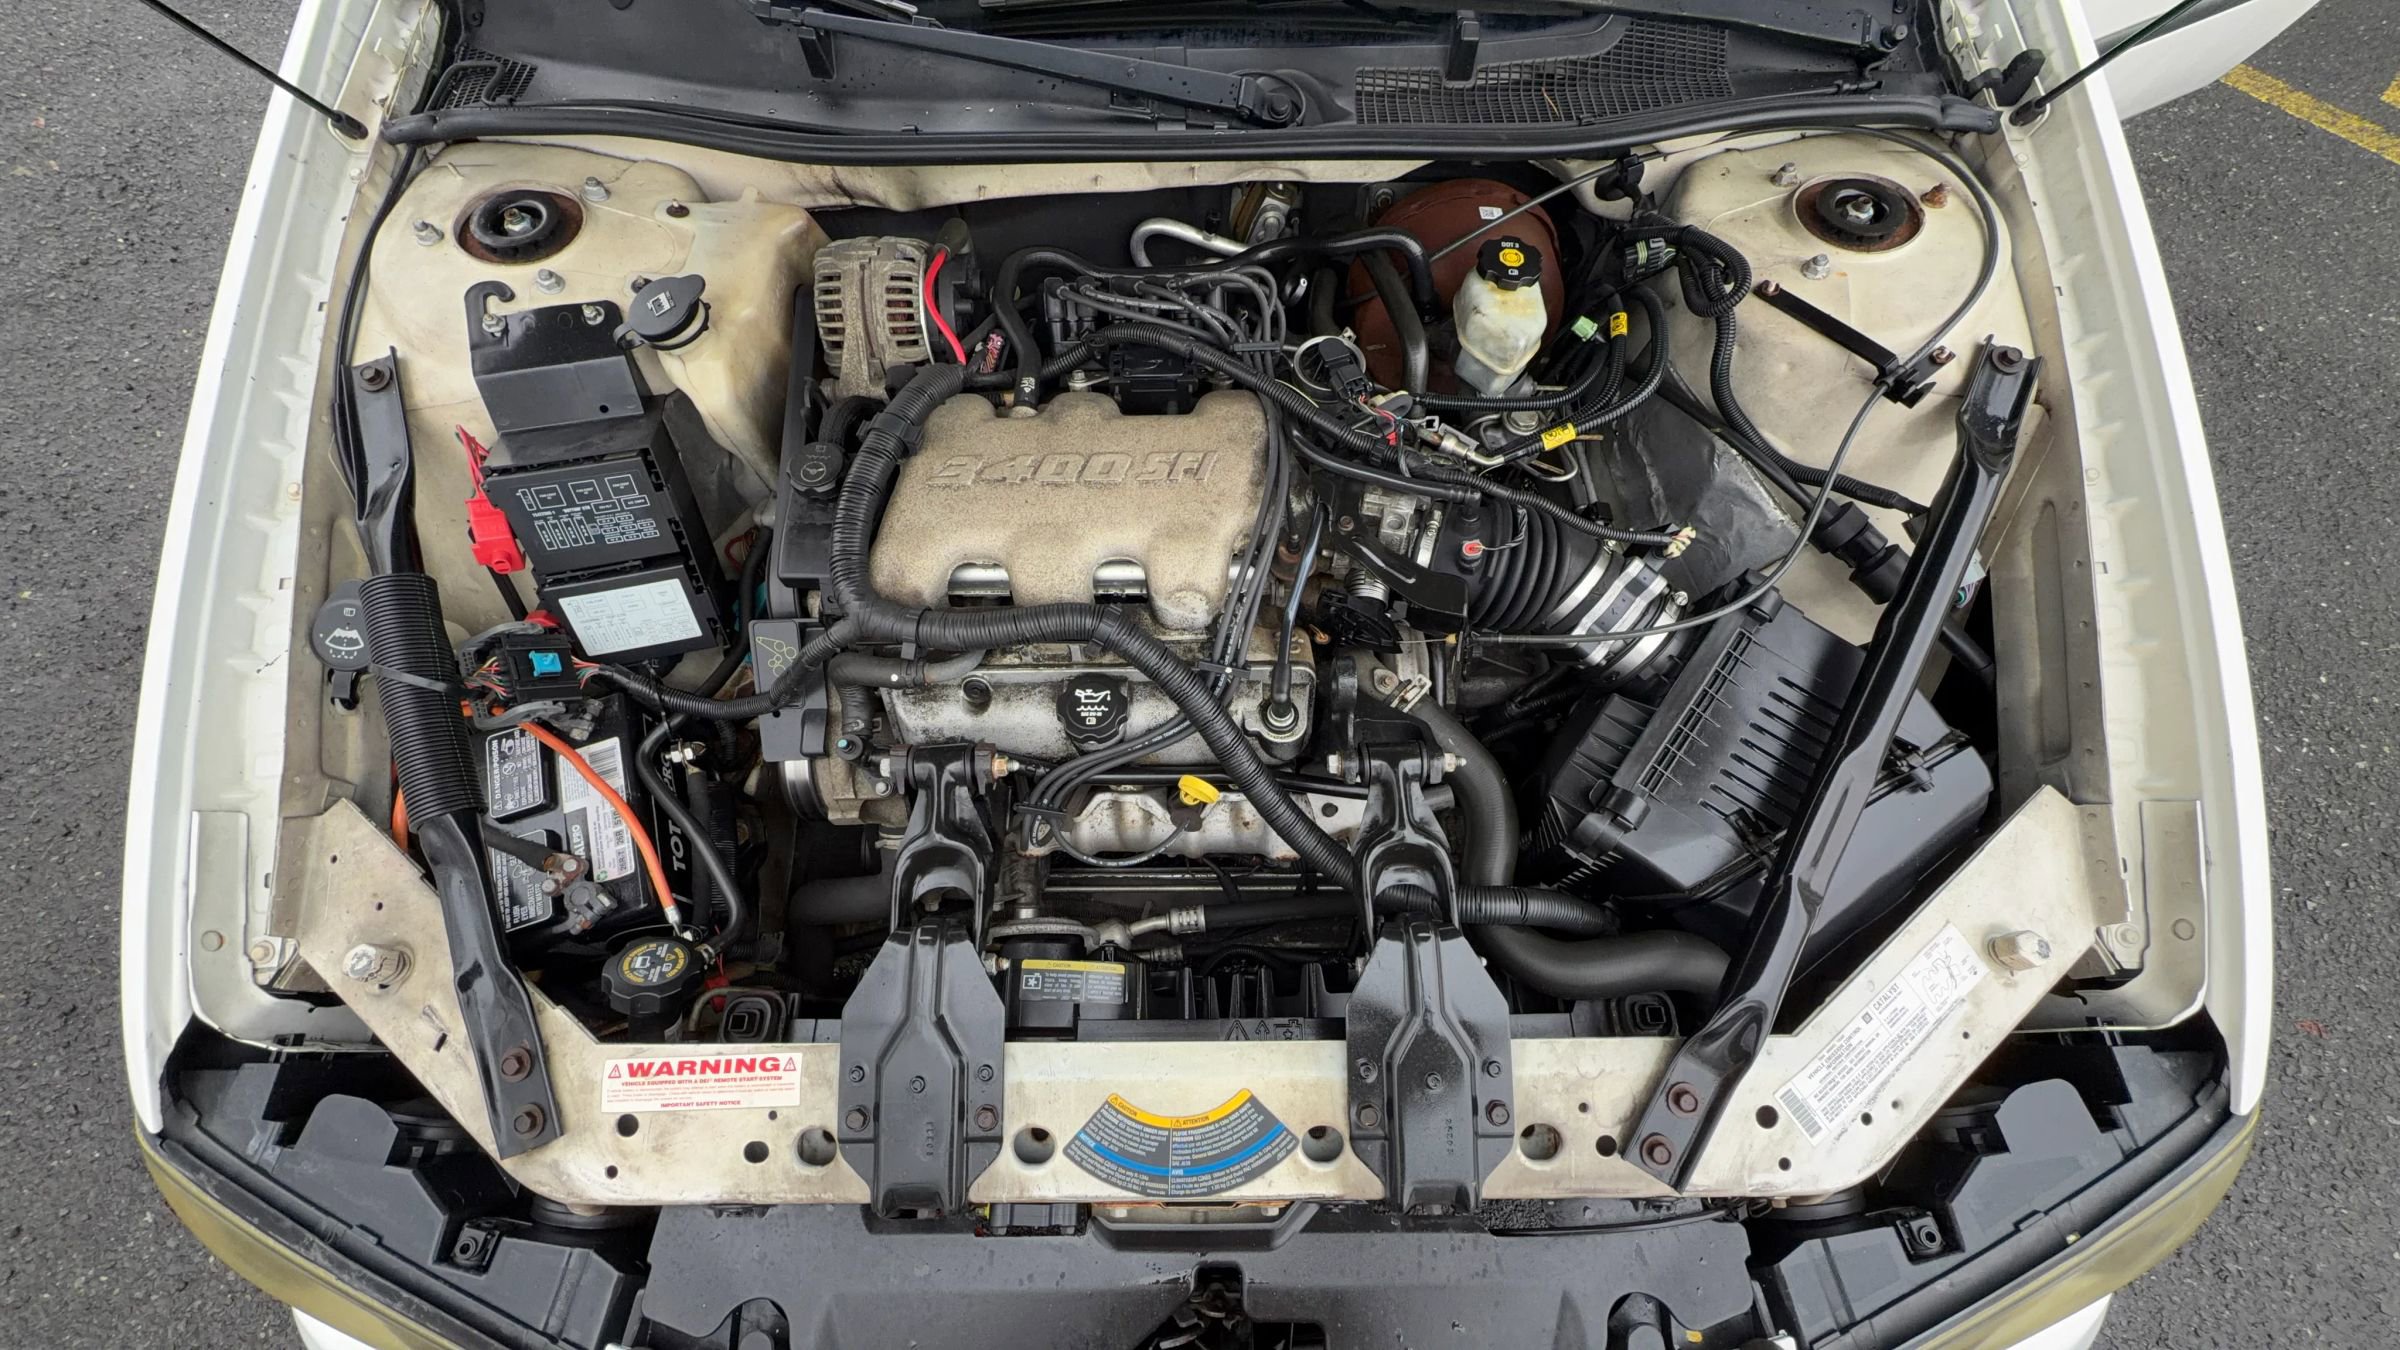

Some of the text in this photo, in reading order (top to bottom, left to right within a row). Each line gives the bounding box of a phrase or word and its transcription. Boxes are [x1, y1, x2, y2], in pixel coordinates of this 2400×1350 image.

[925, 450, 1218, 486] 3400 SFI
[1872, 983, 1899, 1010] CATALYST
[627, 1056, 781, 1078] WARNING
[1118, 1101, 1137, 1116] CAUTION
[1183, 1115, 1209, 1125] ATTENTION
